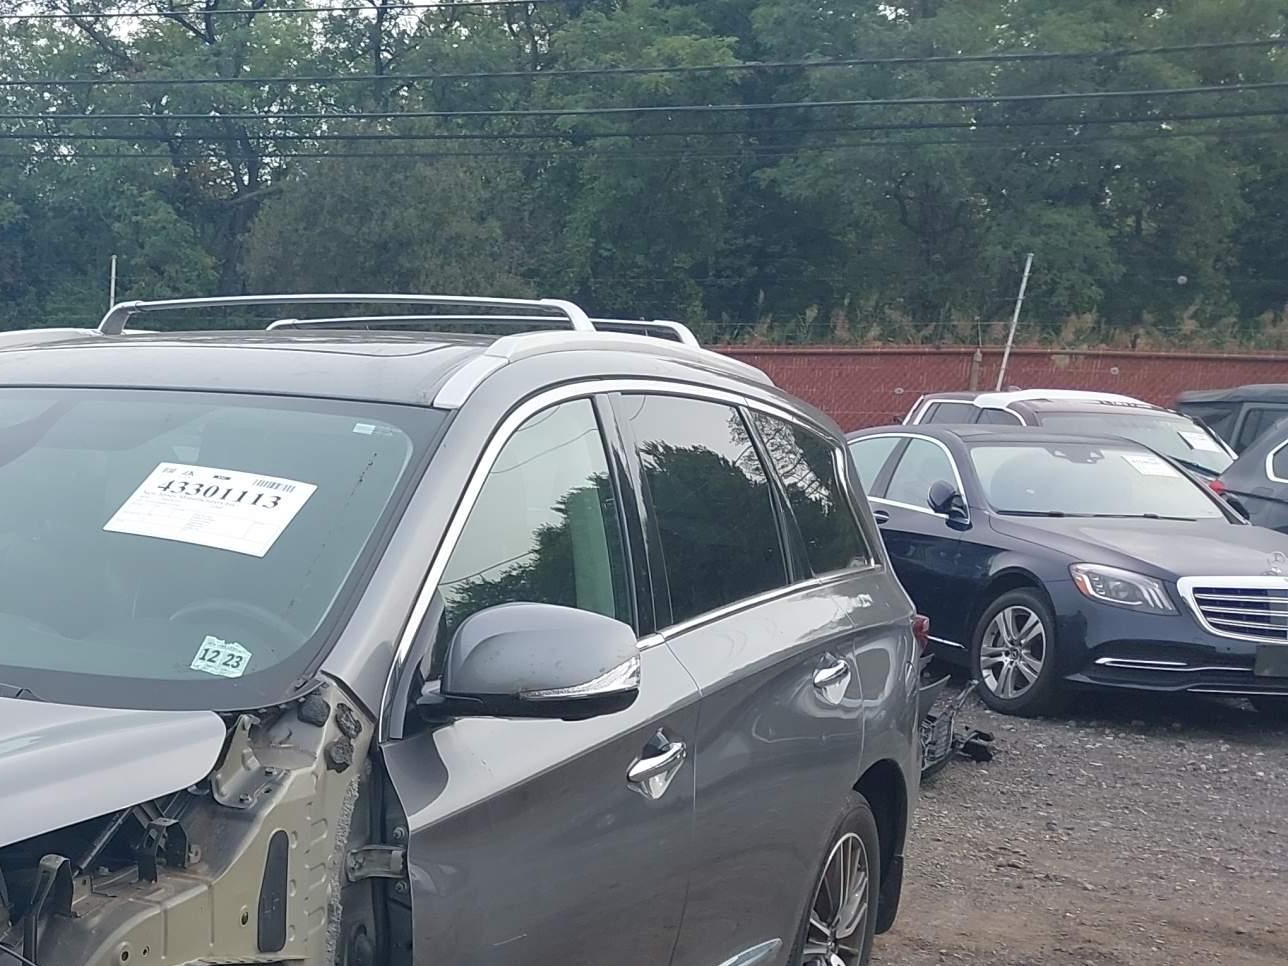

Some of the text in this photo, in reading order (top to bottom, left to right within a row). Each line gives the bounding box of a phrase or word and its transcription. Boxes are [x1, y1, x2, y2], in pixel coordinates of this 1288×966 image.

[157, 479, 282, 509] 43301113
[199, 648, 243, 668] 12 23
